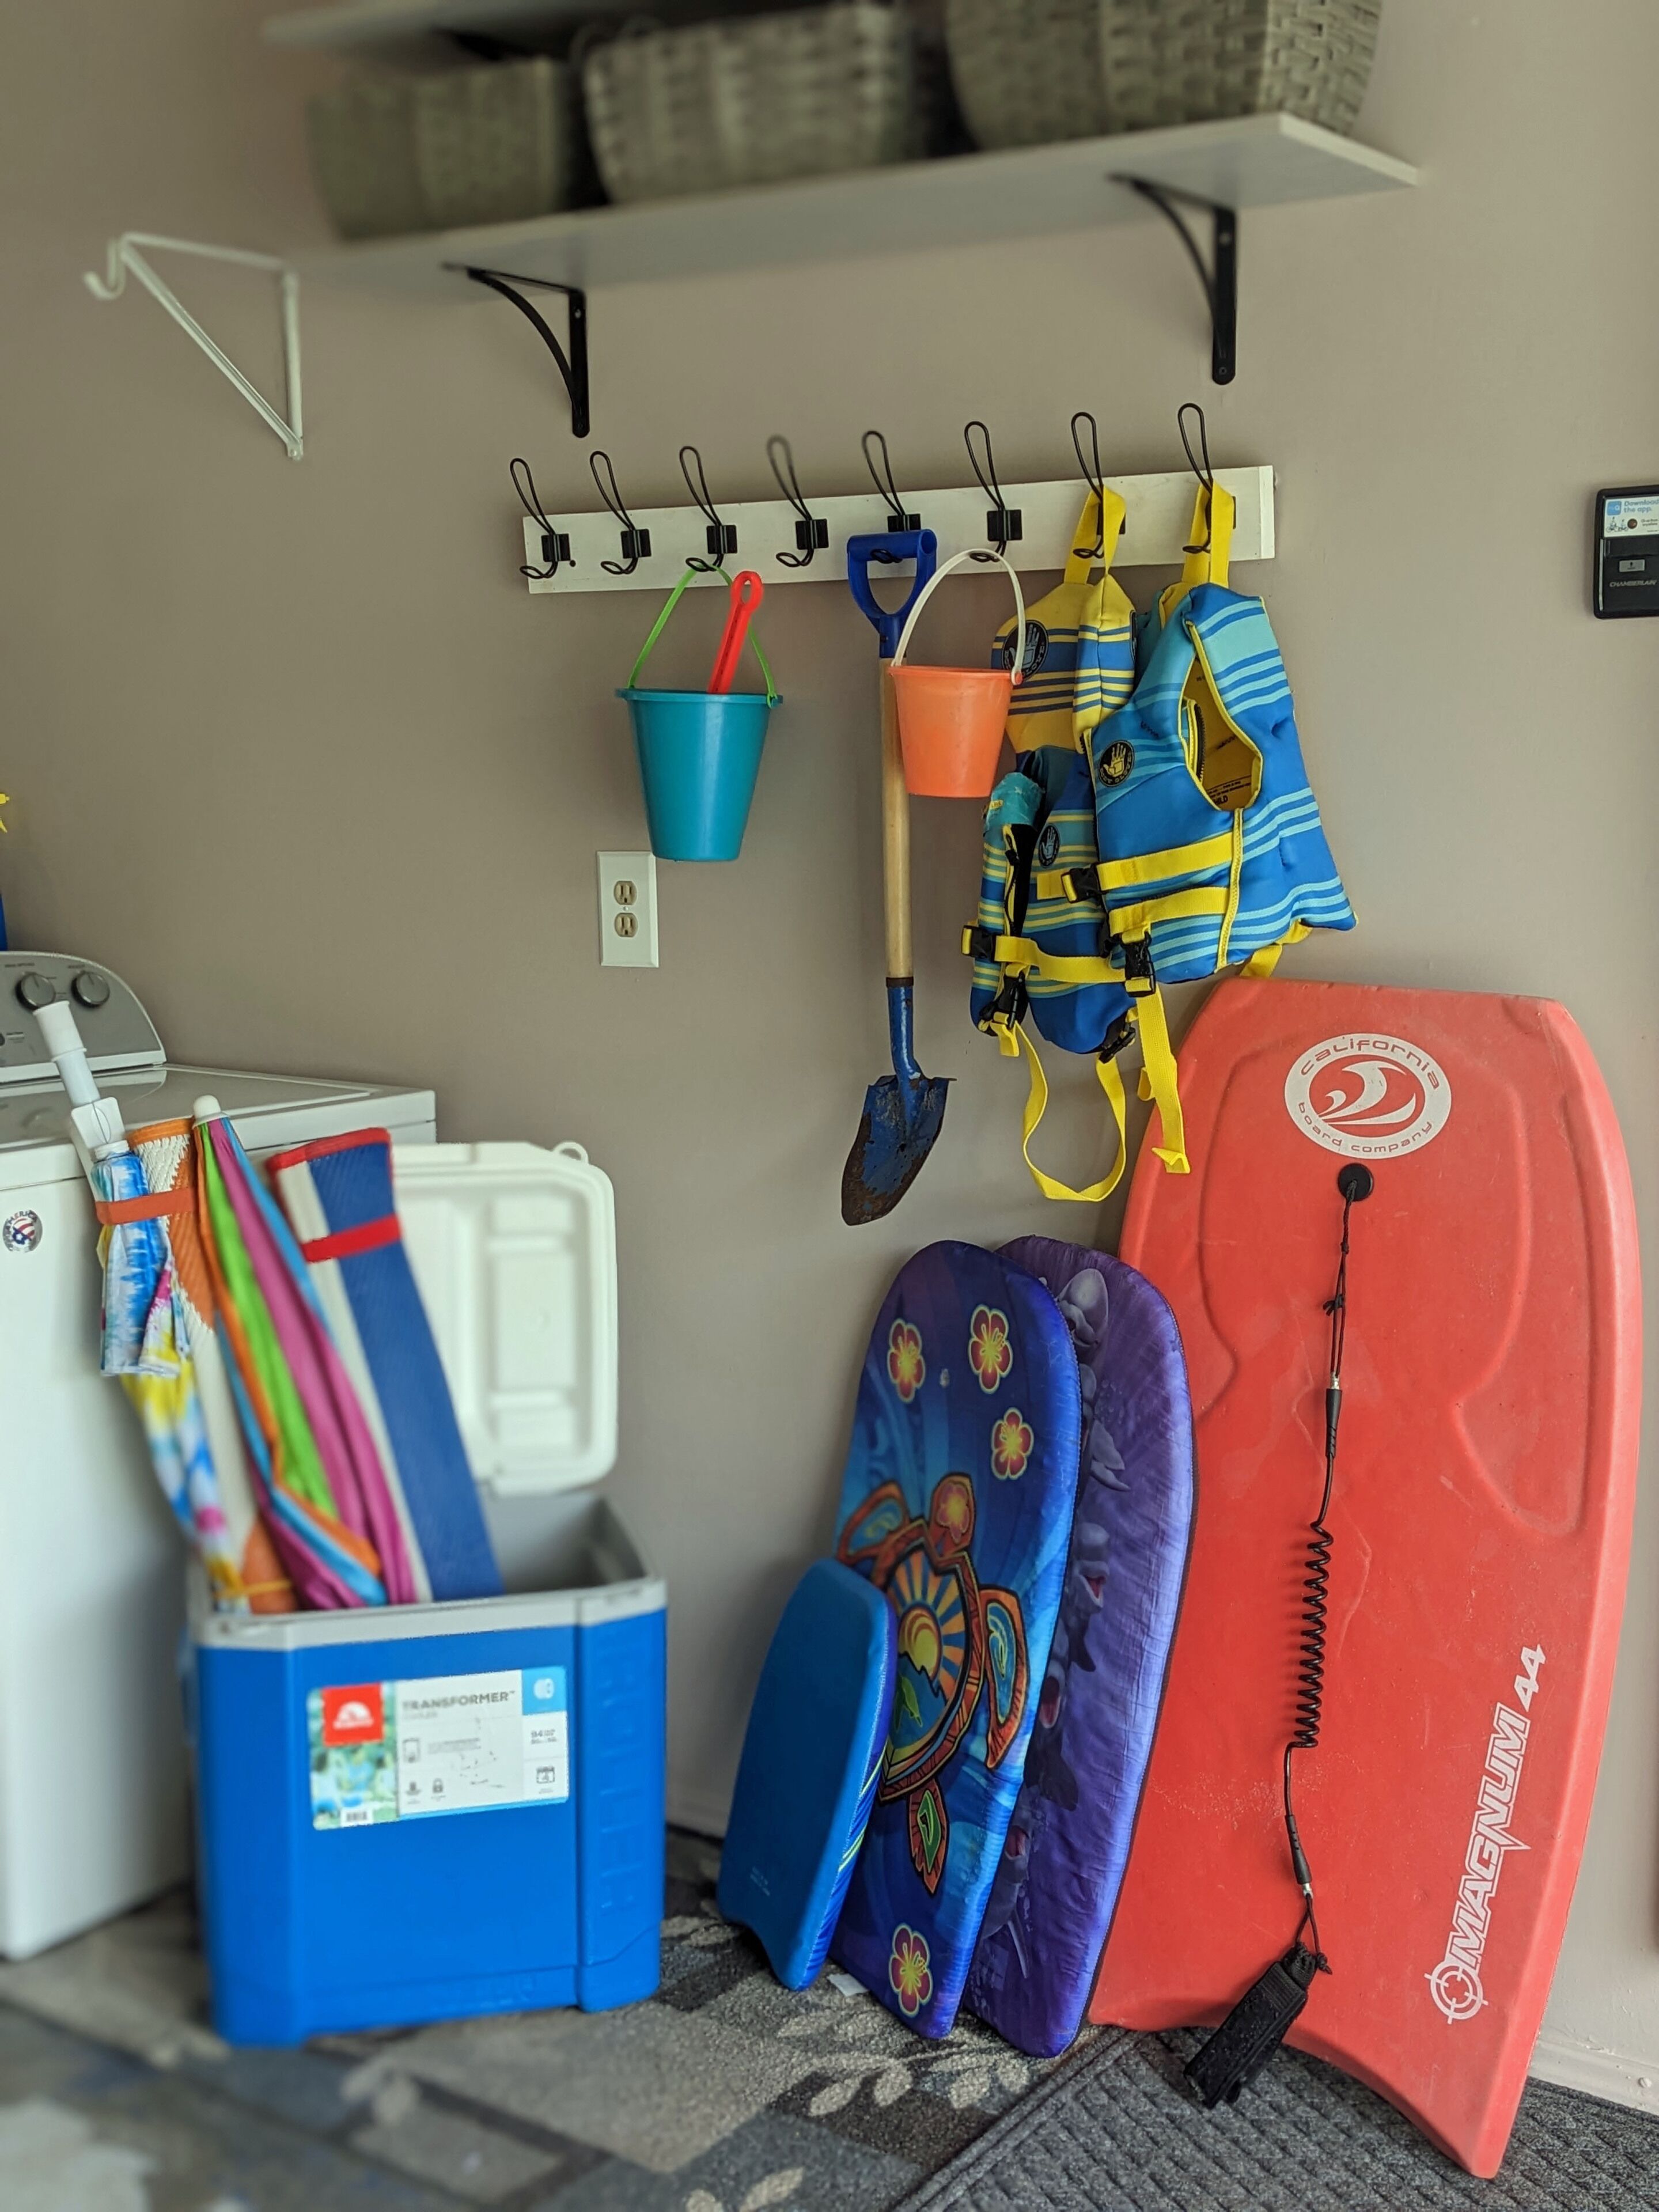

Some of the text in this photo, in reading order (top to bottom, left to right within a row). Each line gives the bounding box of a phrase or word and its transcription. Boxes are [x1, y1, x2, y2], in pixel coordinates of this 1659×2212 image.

[1298, 1101, 1433, 1153] board company
[1445, 1643, 1546, 1975] MAGNUM 44
